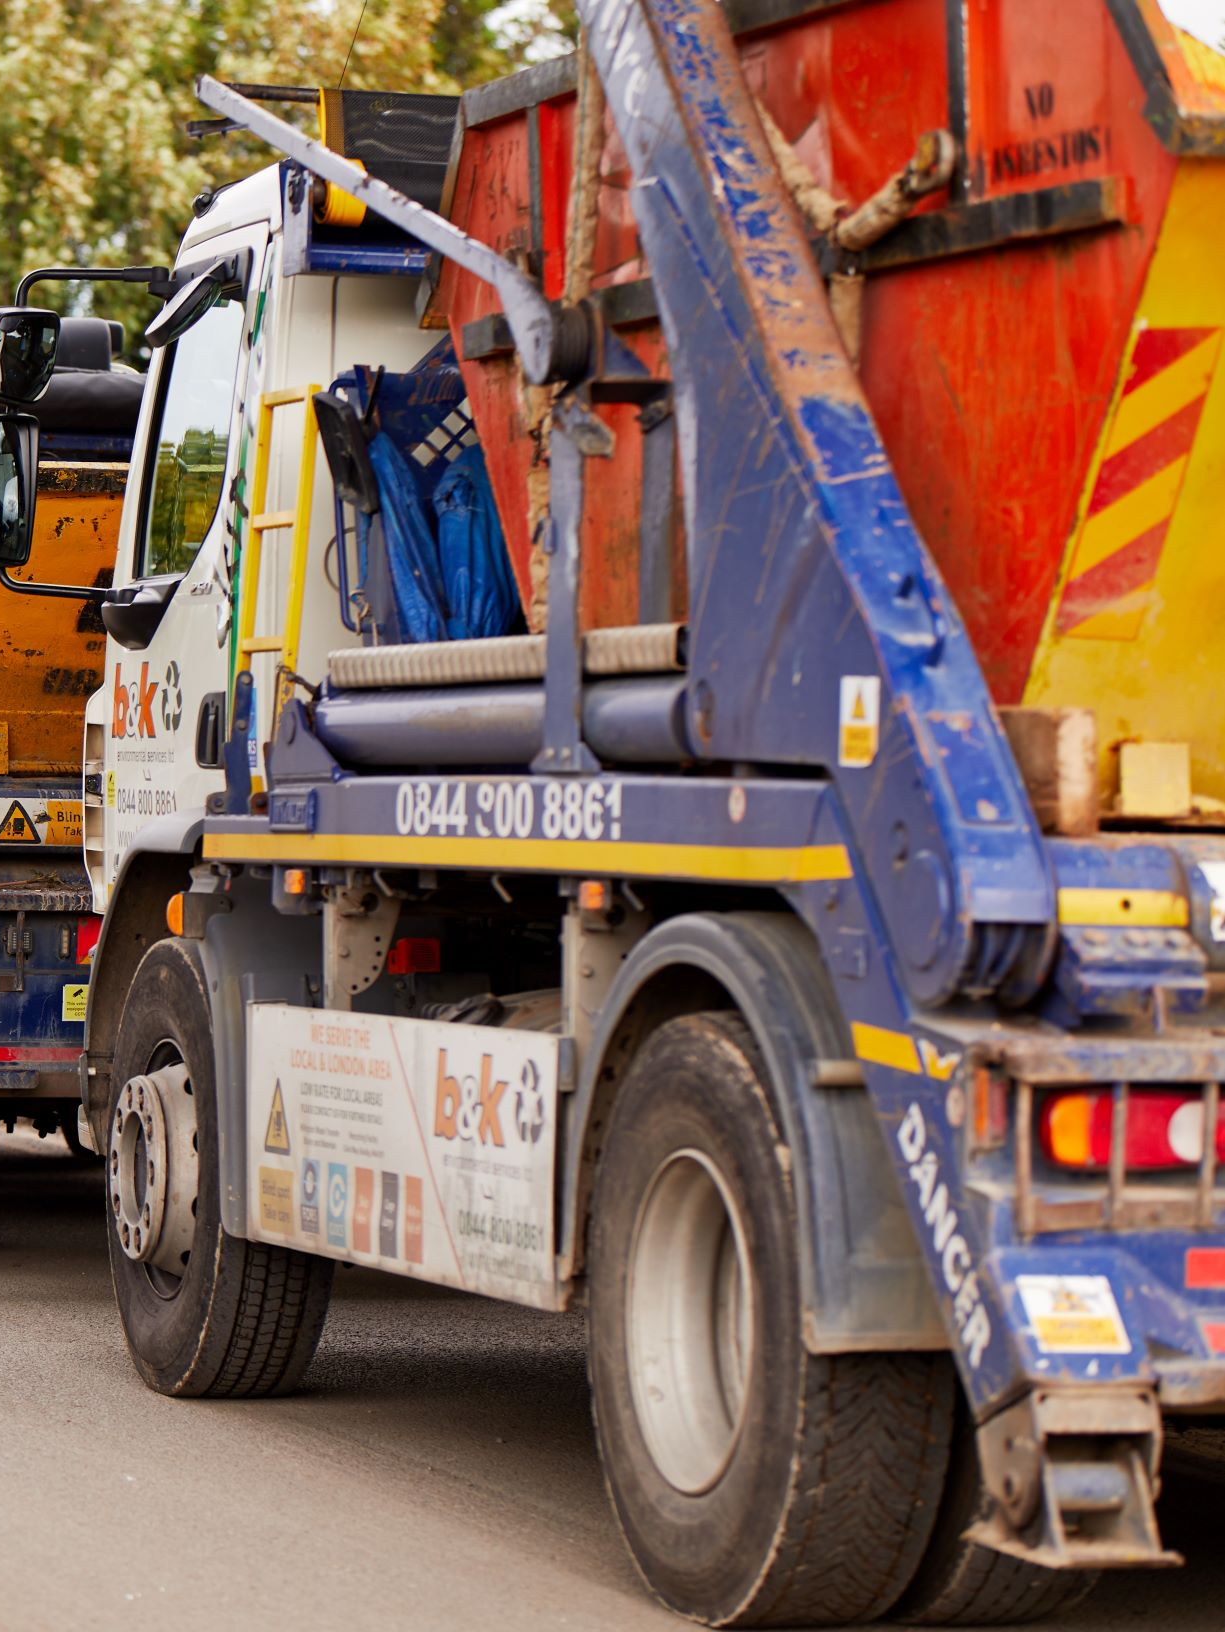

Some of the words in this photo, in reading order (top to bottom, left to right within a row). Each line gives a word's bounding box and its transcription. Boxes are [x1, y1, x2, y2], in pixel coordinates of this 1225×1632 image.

[1023, 82, 1054, 121] NO
[112, 661, 160, 740] b&k
[57, 811, 83, 823] Blin
[117, 788, 136, 814] 0844
[138, 789, 153, 815] 800
[155, 789, 177, 816] 8861
[395, 781, 468, 836] 0844
[64, 826, 83, 837] Tak
[435, 1047, 509, 1148] b&k
